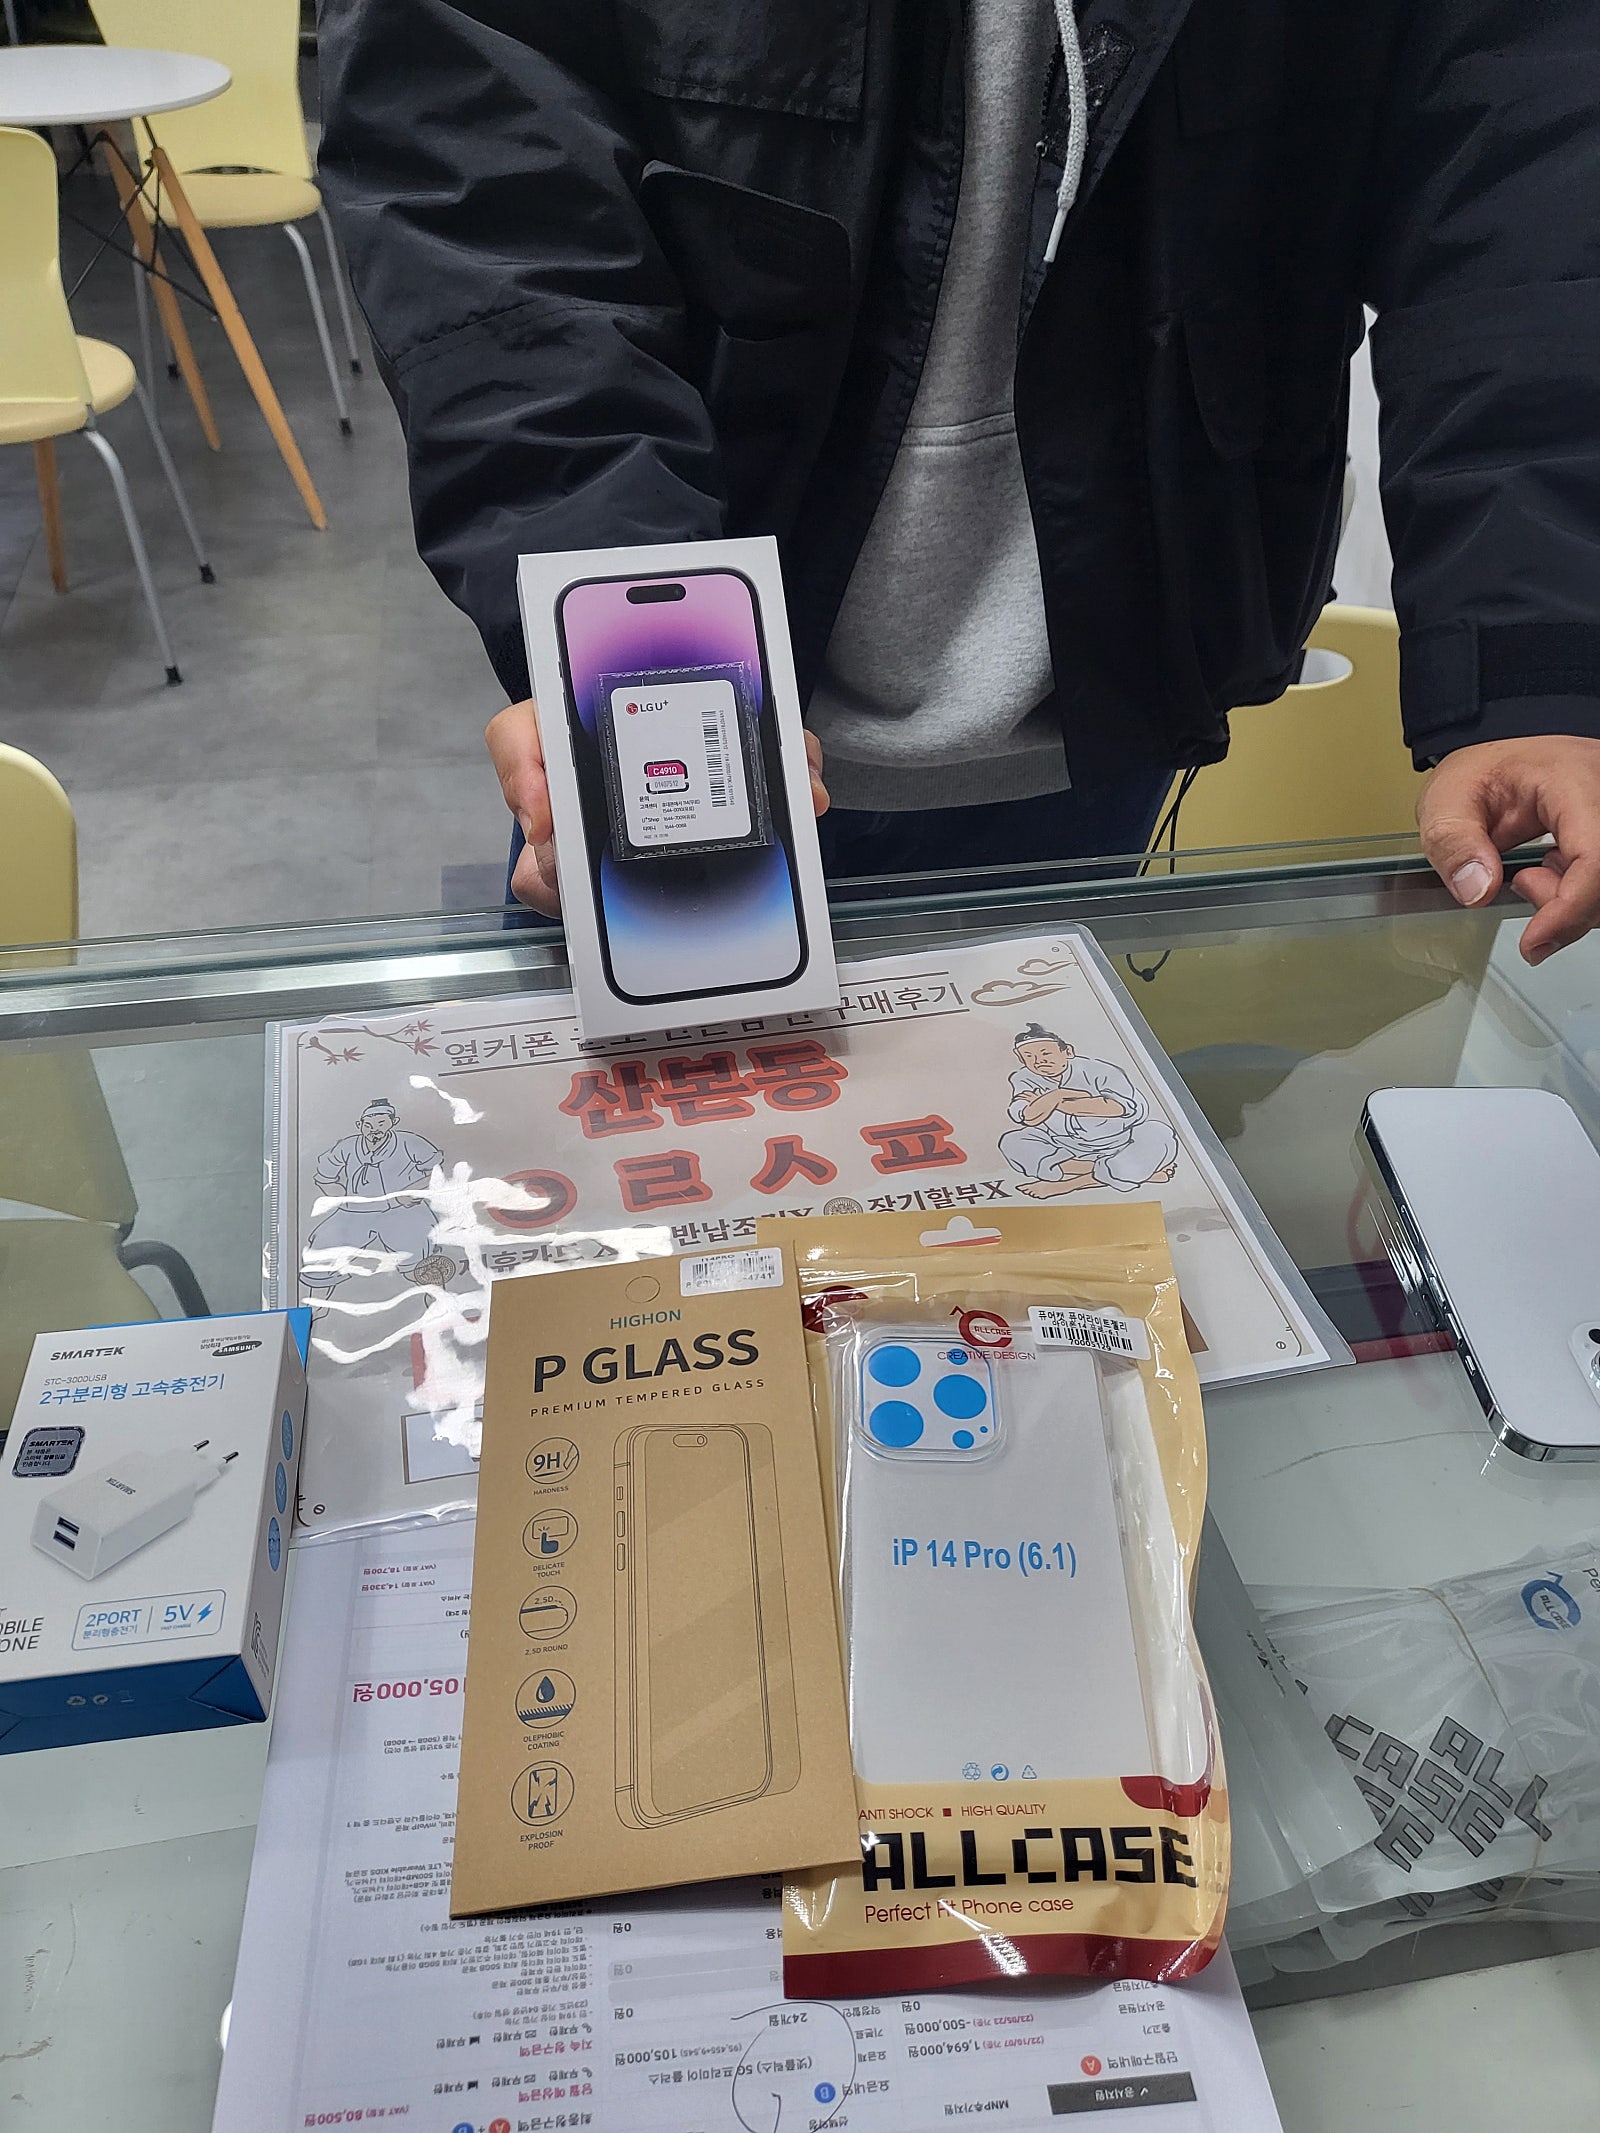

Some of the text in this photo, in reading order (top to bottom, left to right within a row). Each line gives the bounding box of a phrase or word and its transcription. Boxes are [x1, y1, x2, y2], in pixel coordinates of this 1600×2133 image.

[653, 766, 678, 776] C4910
[444, 1031, 557, 1067] 옆커폰
[834, 982, 964, 1024] 구매후기
[560, 1039, 849, 1139] 산본동
[868, 1179, 1012, 1212] 장기할부X
[610, 1309, 682, 1330] HIGHON
[974, 1325, 1012, 1336] ALLCASE
[50, 1346, 126, 1361] SMARTEK
[534, 1329, 759, 1393] P GLASS
[937, 1350, 1036, 1361] CREATIVE DESIGN
[44, 1374, 108, 1386] STC-3000USB
[39, 1373, 225, 1405] 2구분리형 고속충전기
[530, 1378, 765, 1417] PREMIUM TEMPERED GLASS
[533, 1452, 560, 1472] 9H
[533, 1486, 569, 1496] HARDNESS
[893, 1538, 1077, 1578] iP 14 Pro (6.1)
[532, 1562, 565, 1572] DELICATE
[536, 1570, 560, 1578] TOUCH
[534, 1596, 554, 1604] 2.5D
[85, 1604, 195, 1628] 2PORT 5V
[82, 1625, 138, 1640] 분리형충전기
[524, 1643, 568, 1656] 2.5D ROUND
[523, 1730, 564, 1743] OLEPHOBIC
[527, 1740, 560, 1751] COATING
[858, 1803, 1047, 1820] ANTI SHOCK HIGH QUALITY
[520, 1829, 564, 1842] EXPLOSION
[528, 1840, 554, 1850] PROOF
[860, 1826, 1199, 1892] ALLCASE
[865, 1901, 933, 1924] Perfect
[962, 1898, 1022, 1916] Phone
[1028, 1898, 1074, 1912] case
[612, 1922, 632, 1934] 0원
[901, 2000, 920, 2013] 0원
[1118, 2001, 1166, 2014] 공시지원금
[614, 2005, 880, 2028] 약정할인 24개월 0원
[854, 2028, 884, 2040] 기본료
[904, 2019, 971, 2036] -500,000원
[1142, 2023, 1170, 2036] 출고가
[436, 2024, 578, 2050] 무제한 무제한 무제한
[519, 2040, 592, 2058] 지속 청구금액
[857, 2050, 887, 2063] 요금제
[908, 2039, 980, 2058] 1,694,000원
[614, 2048, 678, 2067] 105,000원
[756, 2056, 812, 2074] (넷플릭스)
[1085, 2052, 1178, 2072] 단말구매내역 A
[434, 2069, 578, 2095] 무제한 무제한 무제한
[648, 2070, 684, 2085] 플러스
[687, 2066, 734, 2082] 프리미어
[518, 2088, 566, 2104] 예상금액
[842, 2080, 890, 2096] 요금내역
[1094, 2086, 1135, 2102] 공시지원
[944, 2100, 1009, 2117] MNP추가지원
[517, 2112, 592, 2132] 최종청구금액
